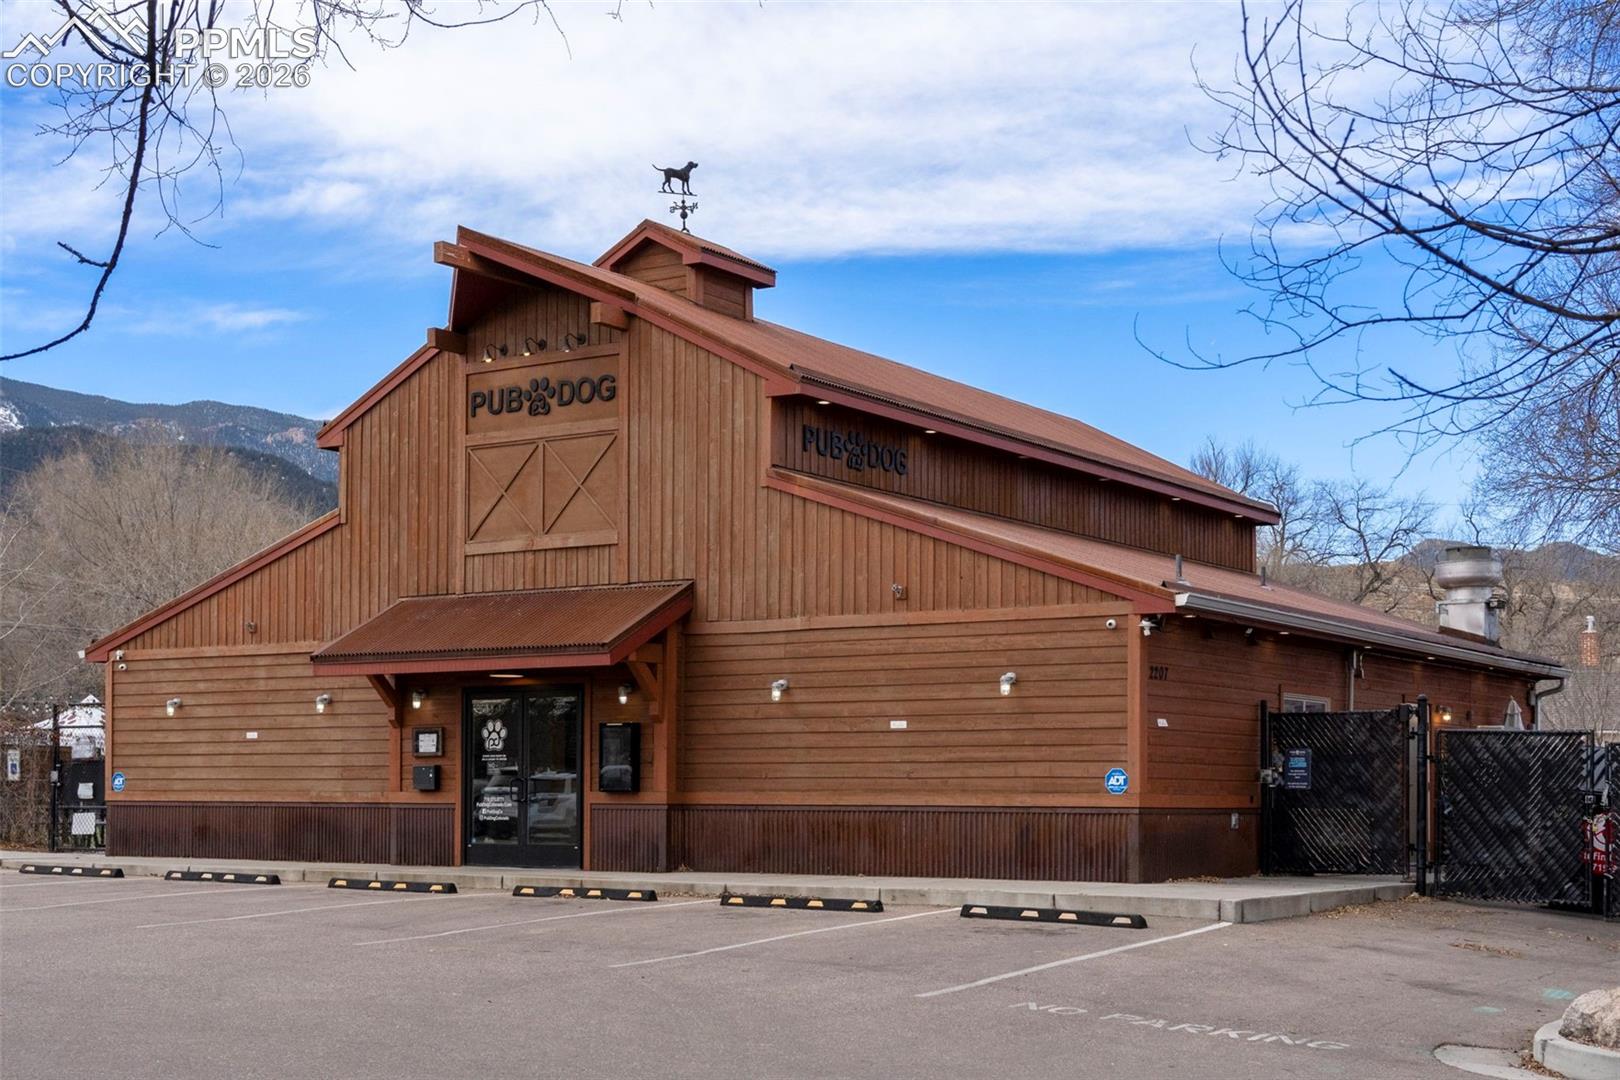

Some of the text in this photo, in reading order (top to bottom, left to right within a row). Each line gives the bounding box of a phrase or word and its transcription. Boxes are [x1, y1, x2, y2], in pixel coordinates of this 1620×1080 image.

[471, 375, 616, 418] PUB DOG
[802, 424, 908, 475] PUB DOG
[1148, 665, 1169, 681] 2207
[1108, 775, 1126, 786] ADT
[1008, 1002, 1350, 1050] NO PARKING
